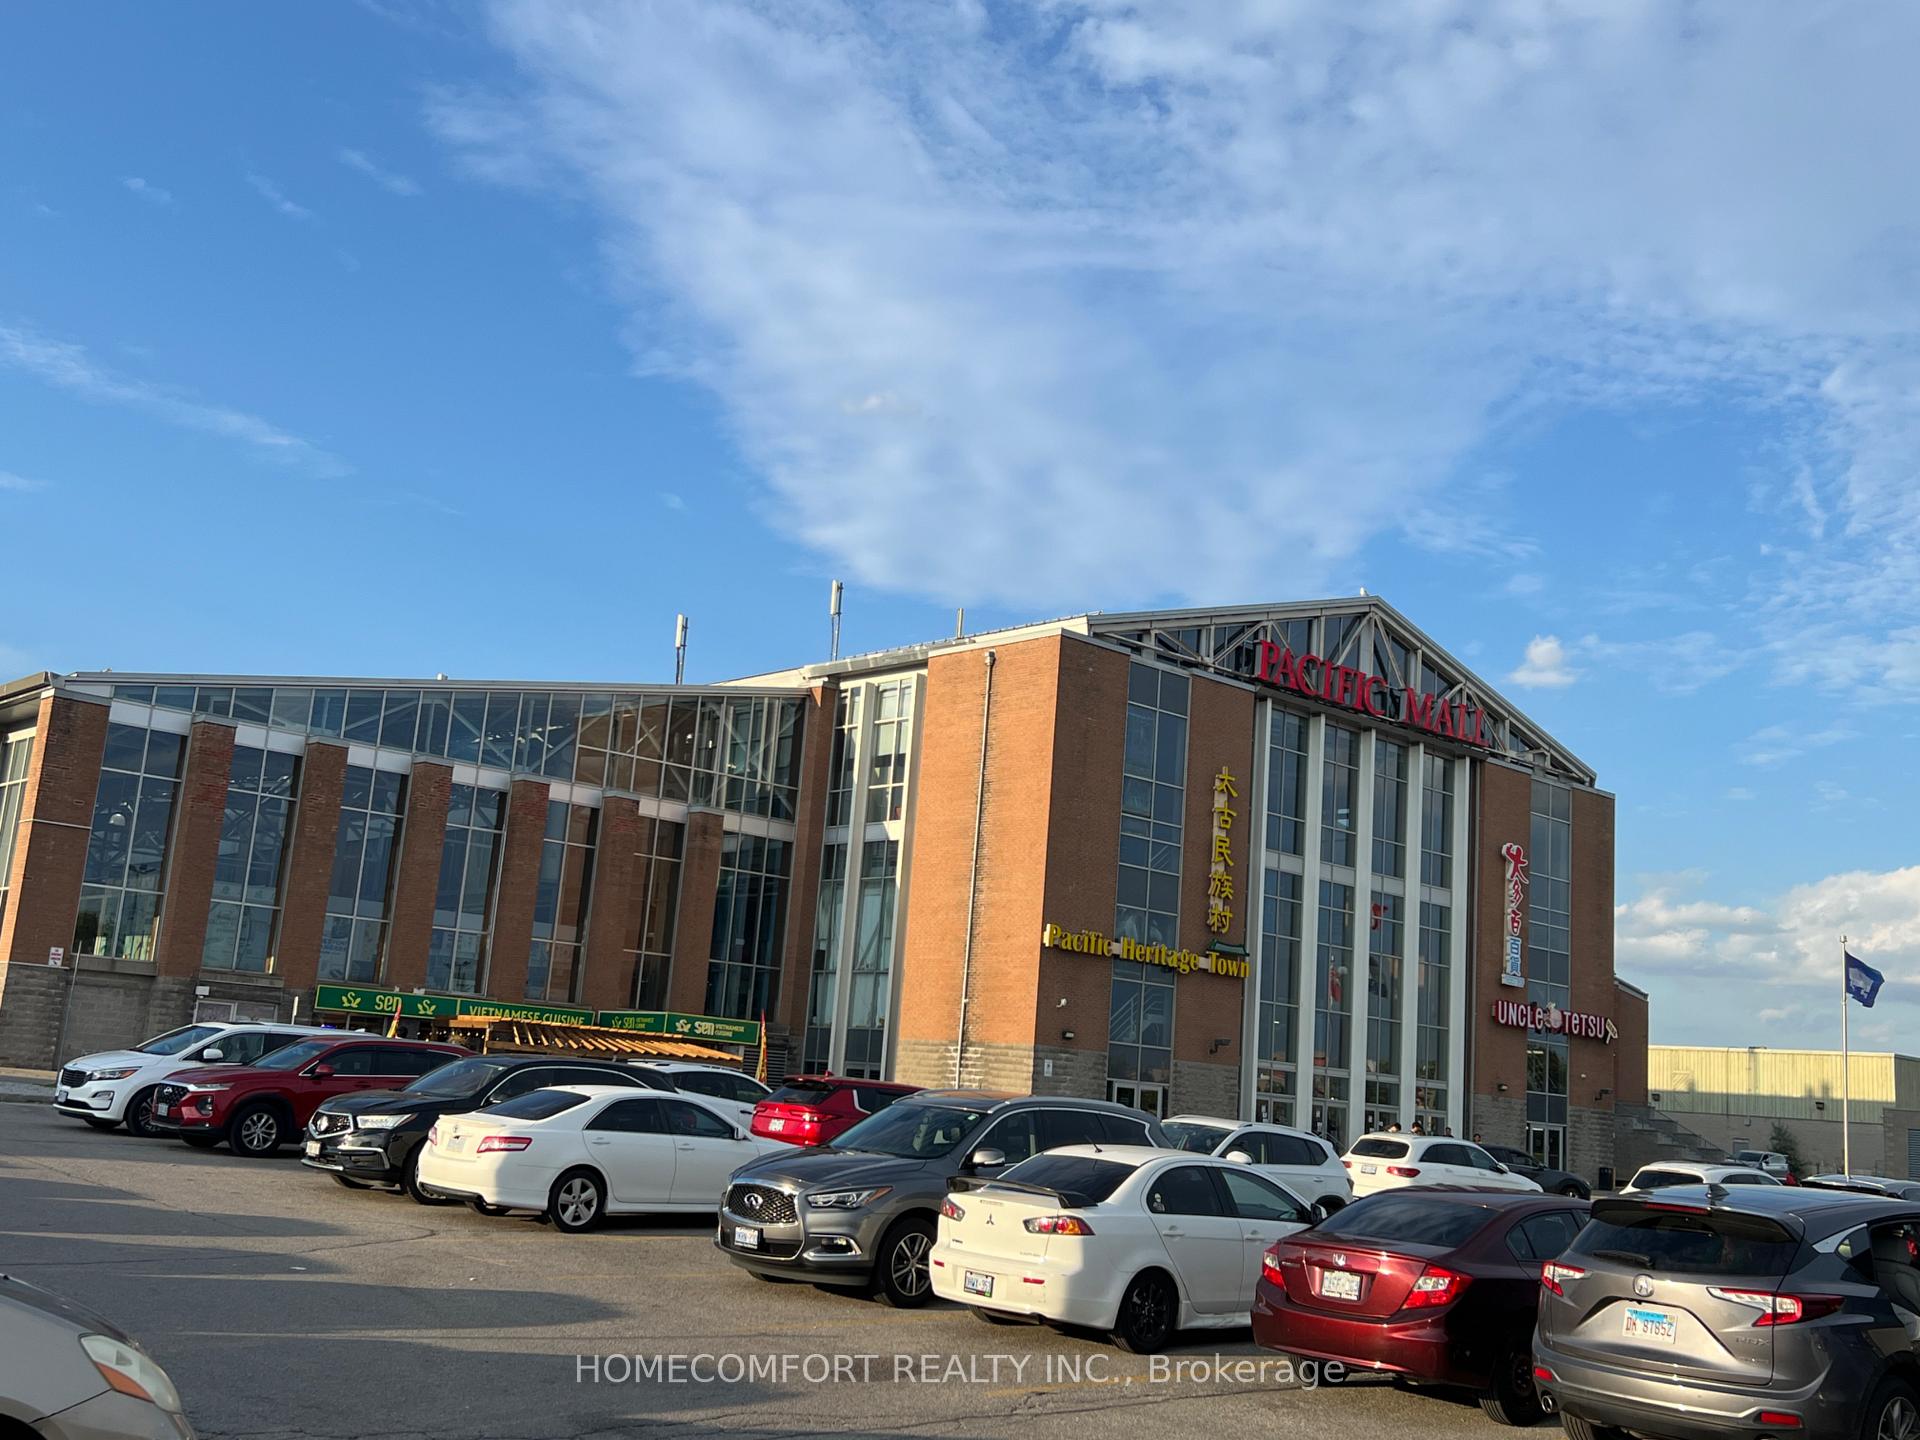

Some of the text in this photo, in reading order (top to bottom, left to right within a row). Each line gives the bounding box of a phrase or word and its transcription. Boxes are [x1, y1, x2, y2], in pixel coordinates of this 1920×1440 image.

[1257, 640, 1489, 748] PACIFIC MALL
[1208, 766, 1239, 934] 太古民族村
[1046, 923, 1250, 979] Pacific Heritage Town
[469, 1005, 586, 1027] VIETNAMESE CUISINE
